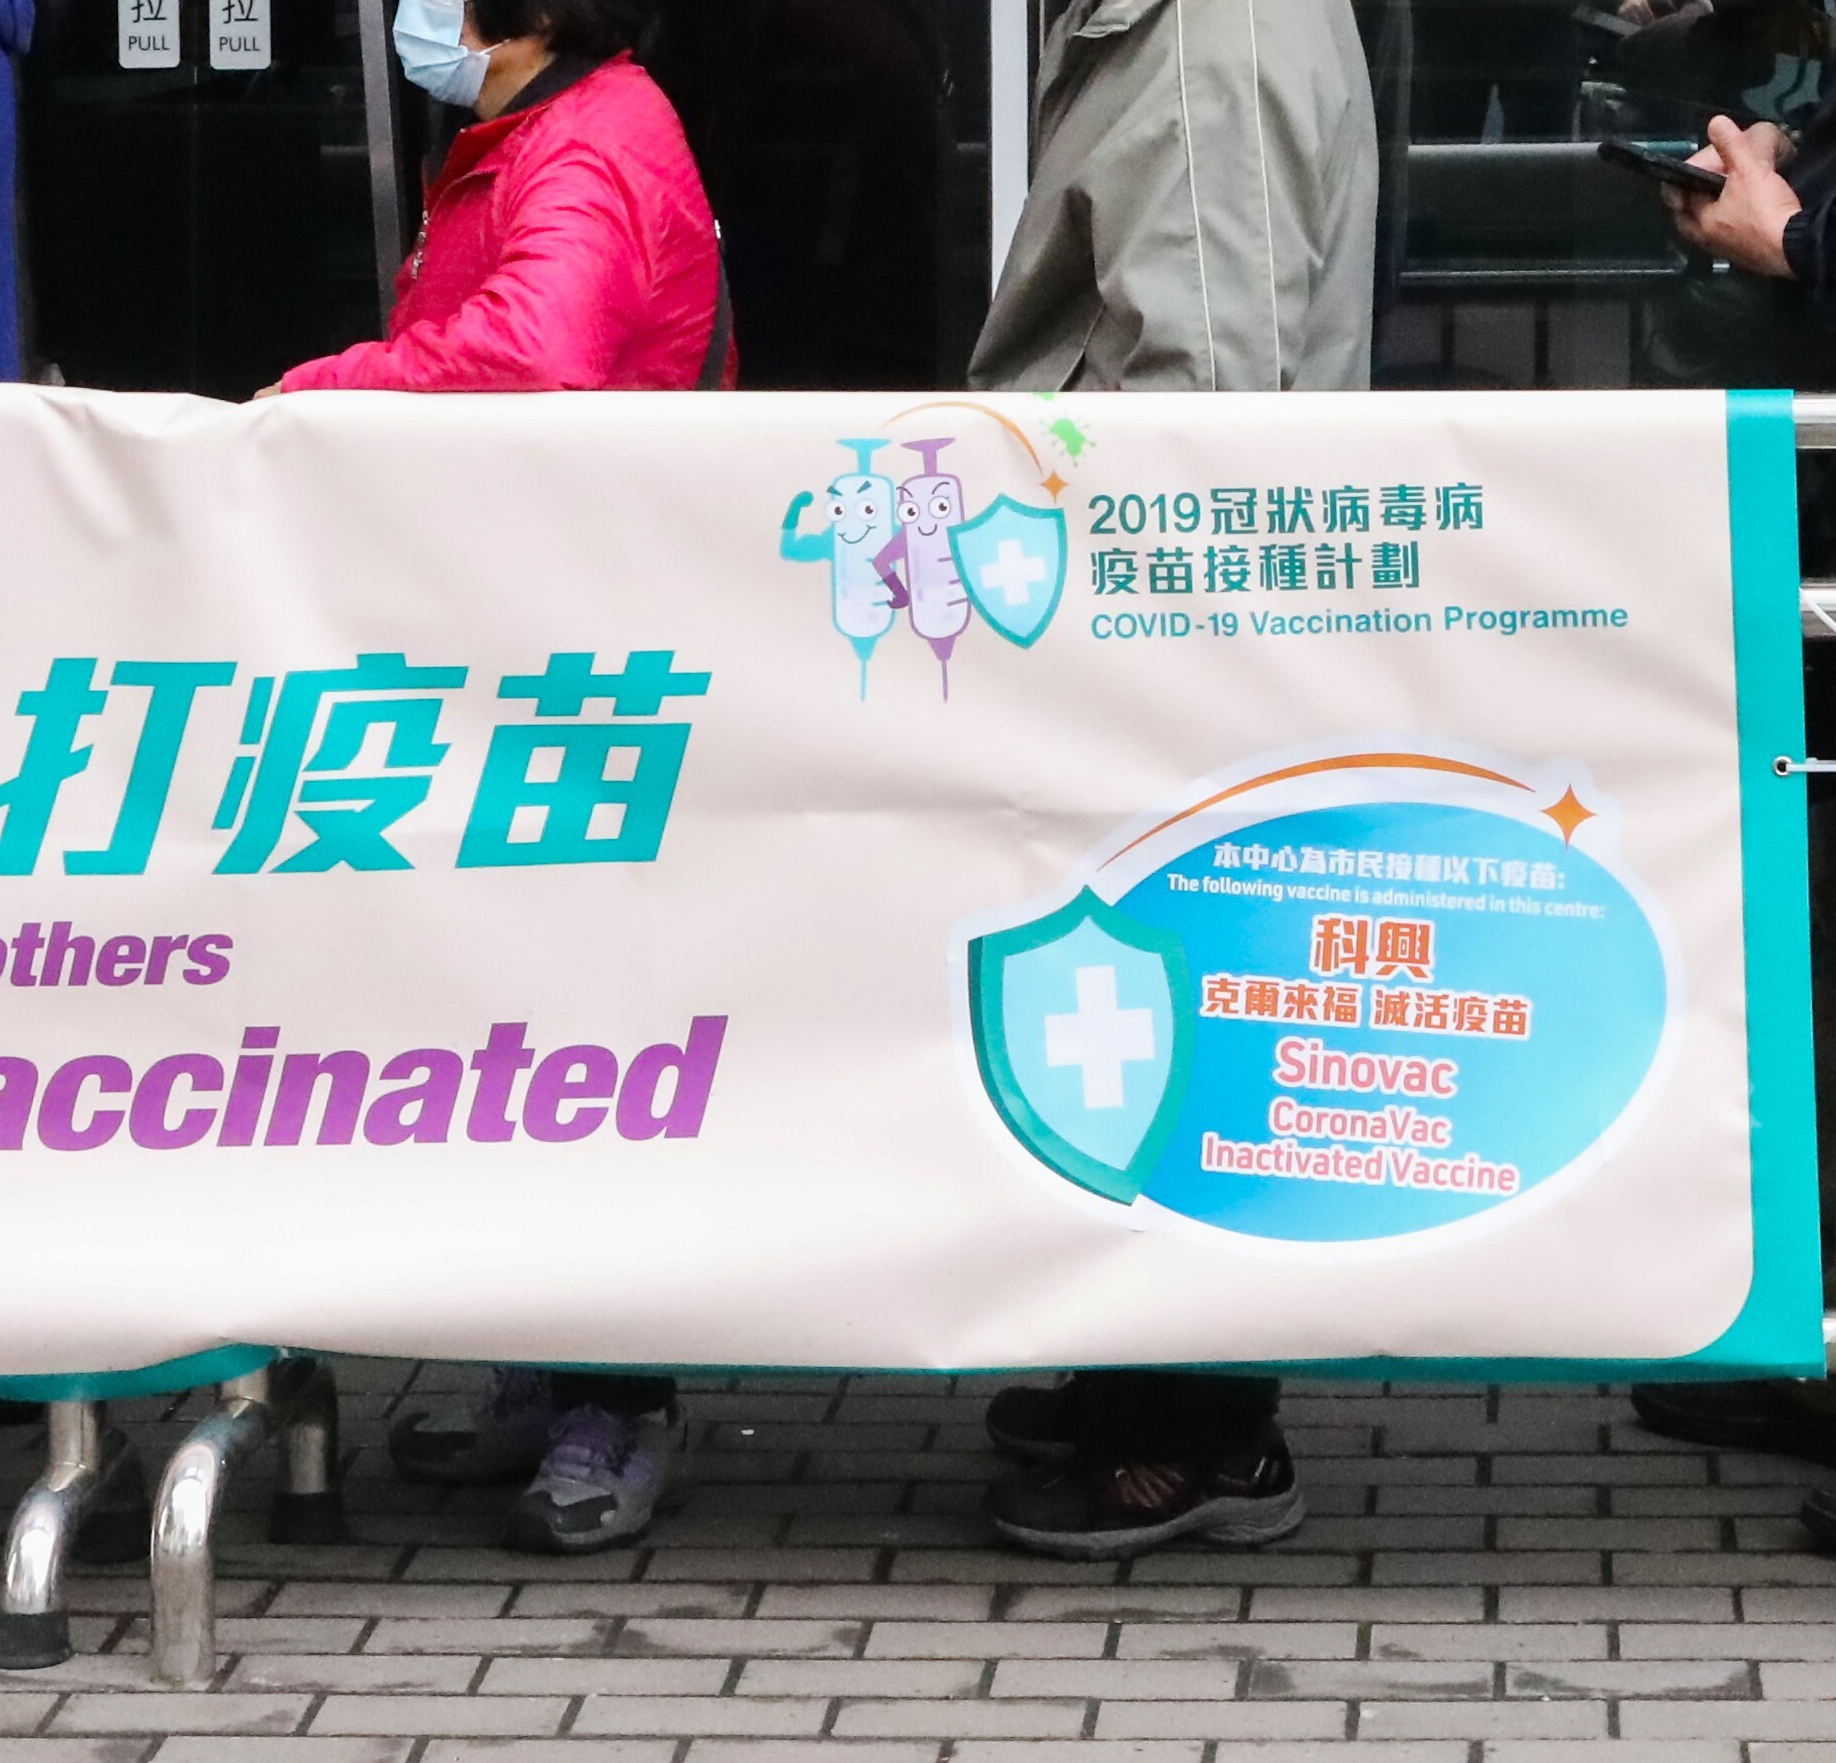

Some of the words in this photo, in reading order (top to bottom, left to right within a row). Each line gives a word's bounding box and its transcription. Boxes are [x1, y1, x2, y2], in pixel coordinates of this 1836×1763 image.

[128, 35, 170, 52] PULL
[219, 36, 261, 53] PULL
[1088, 482, 1483, 535] 2019冠狀病毒病
[1090, 540, 1420, 595] 疫苗接種計劃
[1091, 612, 1239, 640] COVID-19
[1250, 608, 1432, 635] Vaccination
[1444, 605, 1628, 636] Programme
[1167, 873, 1200, 892] The
[1202, 876, 1283, 902] following
[1286, 885, 1351, 903] vaccine
[1354, 887, 1369, 904] is
[1372, 888, 1486, 912] administered
[1489, 897, 1506, 912] in
[1509, 897, 1541, 915] this
[1544, 902, 1606, 919] centre:
[1314, 917, 1430, 979] 科興
[1206, 977, 1358, 1024] 克爾來福
[1374, 989, 1527, 1036] 滅活疫苗
[1275, 1038, 1453, 1097] Sinovac
[1267, 1099, 1447, 1147] CoronaVac
[1199, 1134, 1383, 1187] Inactivated
[1386, 1151, 1516, 1191] Vaccine
